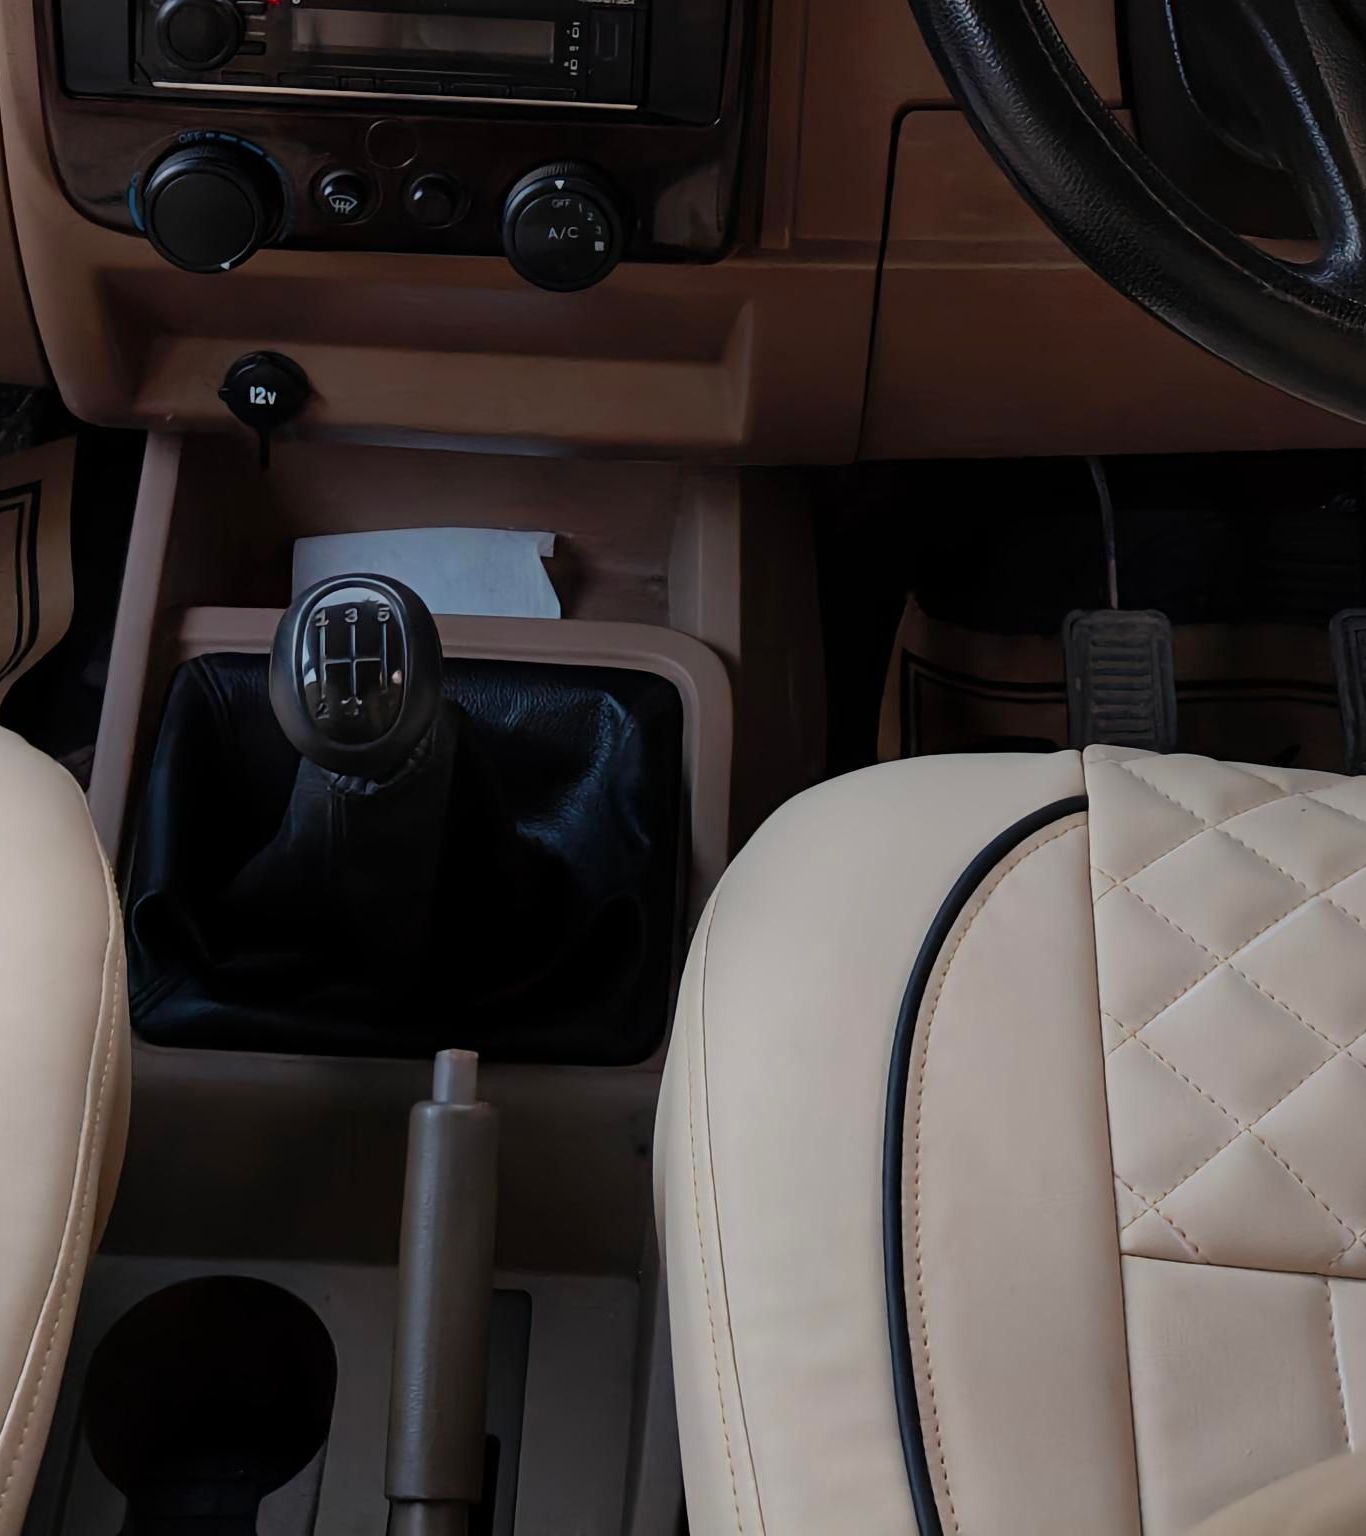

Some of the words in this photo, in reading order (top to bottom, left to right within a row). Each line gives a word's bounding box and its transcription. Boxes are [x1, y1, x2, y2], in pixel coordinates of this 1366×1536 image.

[548, 226, 580, 240] A/C
[314, 609, 330, 627] 1
[344, 607, 359, 624] 3
[377, 607, 391, 622] 5
